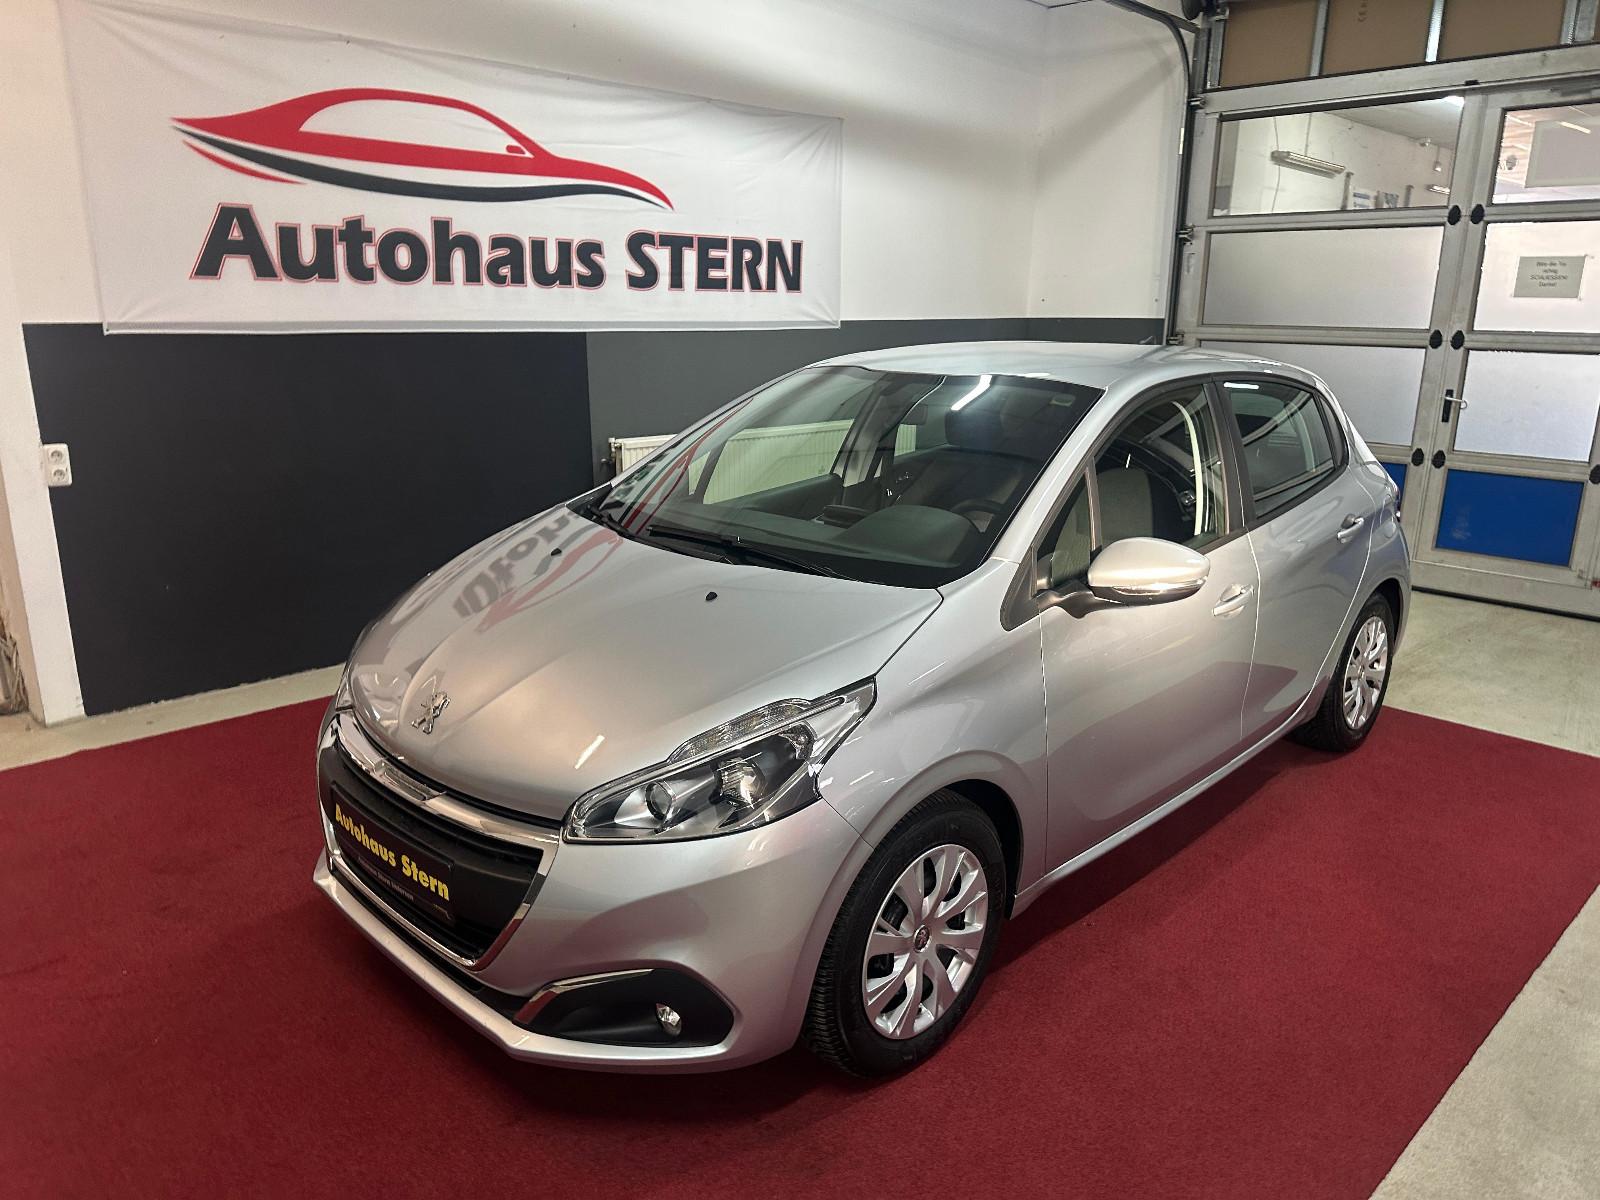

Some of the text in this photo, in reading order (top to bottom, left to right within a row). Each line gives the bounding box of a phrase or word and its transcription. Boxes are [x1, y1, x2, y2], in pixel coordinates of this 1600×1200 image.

[189, 202, 804, 293] Autohaus STERN
[335, 802, 450, 902] Autohaus Stern
